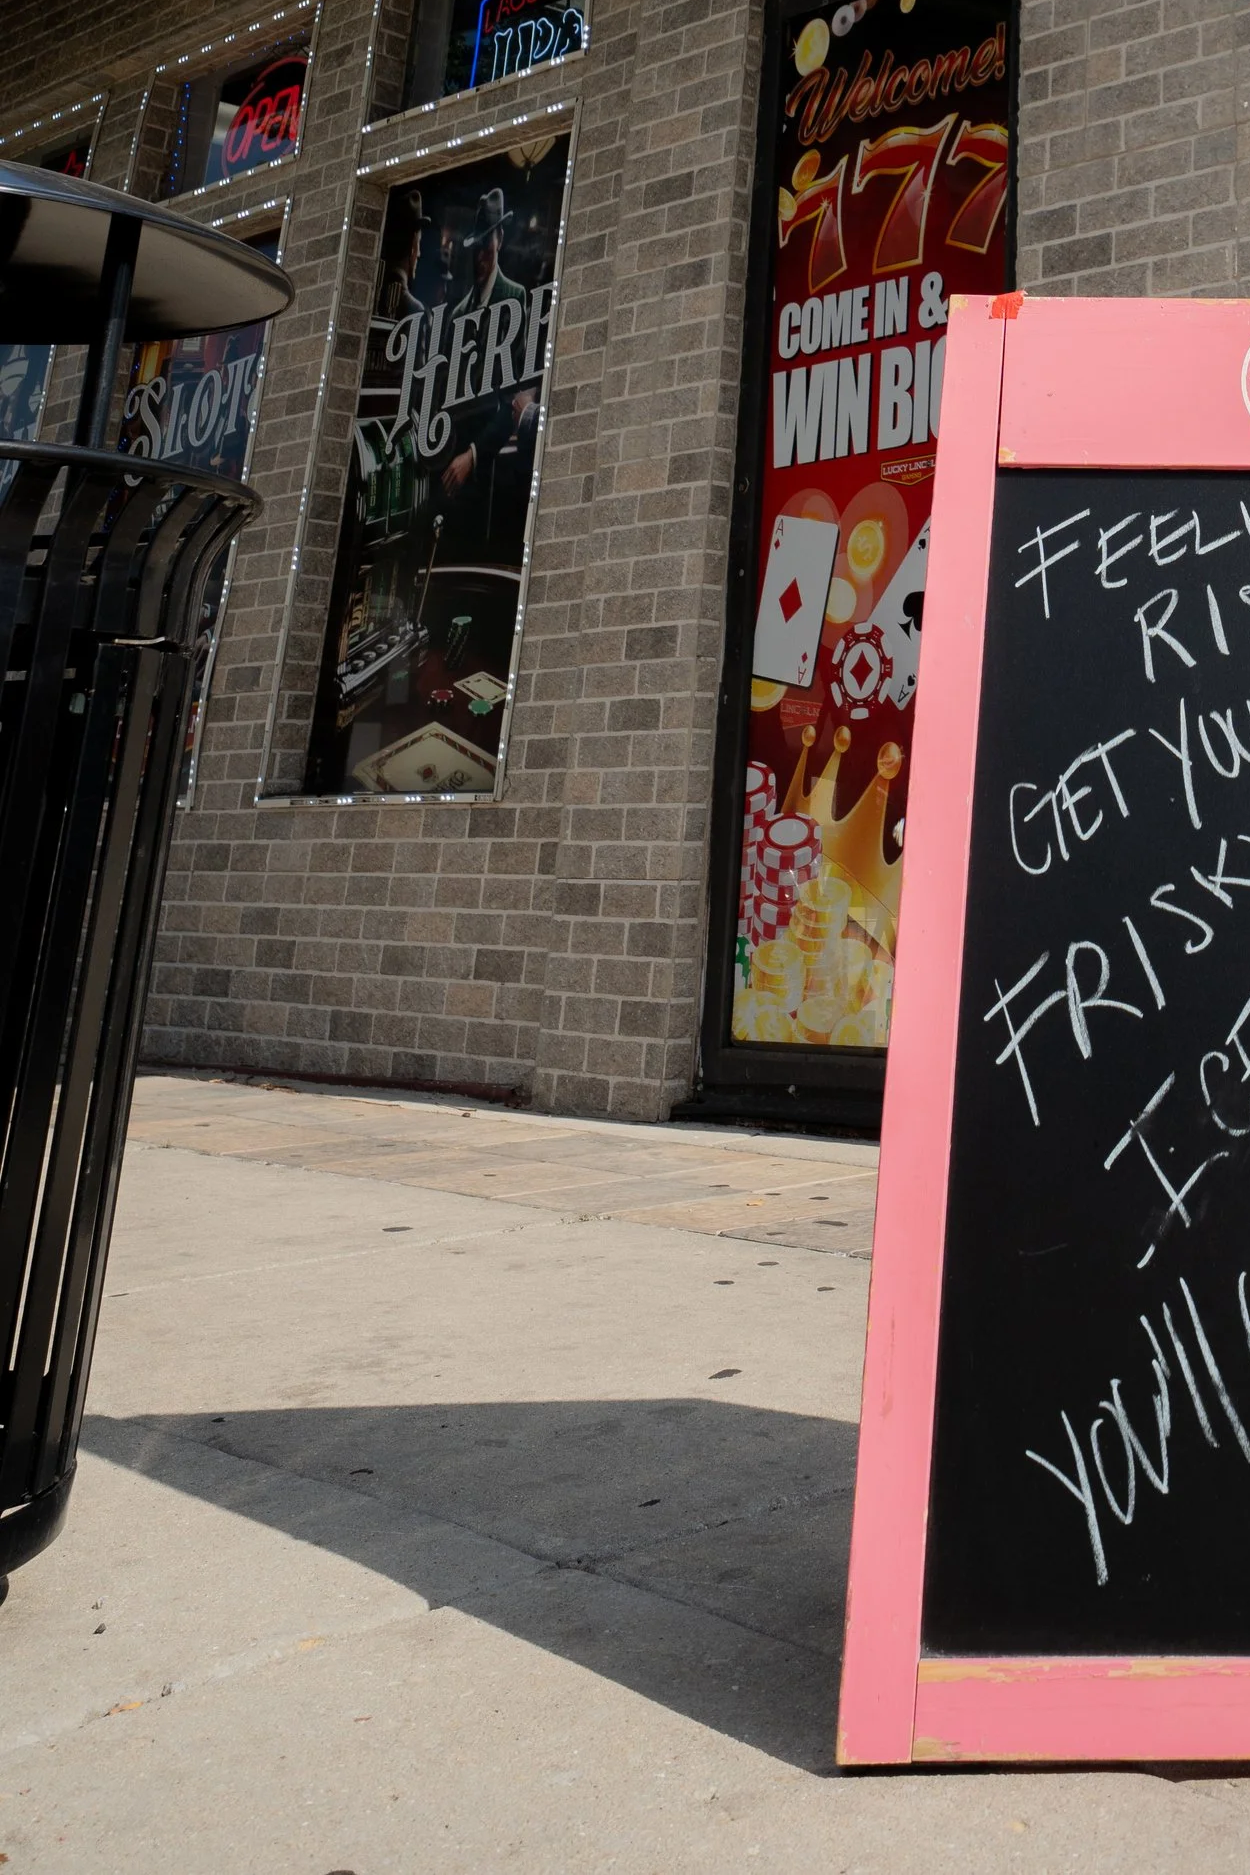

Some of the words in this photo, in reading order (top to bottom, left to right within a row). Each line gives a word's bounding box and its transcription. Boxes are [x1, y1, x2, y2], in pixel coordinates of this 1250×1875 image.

[227, 85, 301, 163] OPEN
[786, 22, 1006, 143] Welcome!
[779, 113, 1009, 293] 777
[778, 289, 869, 360] COME
[874, 277, 910, 339] IN
[918, 271, 947, 329] &
[773, 353, 873, 469] WIN
[1010, 729, 1137, 874] GET
